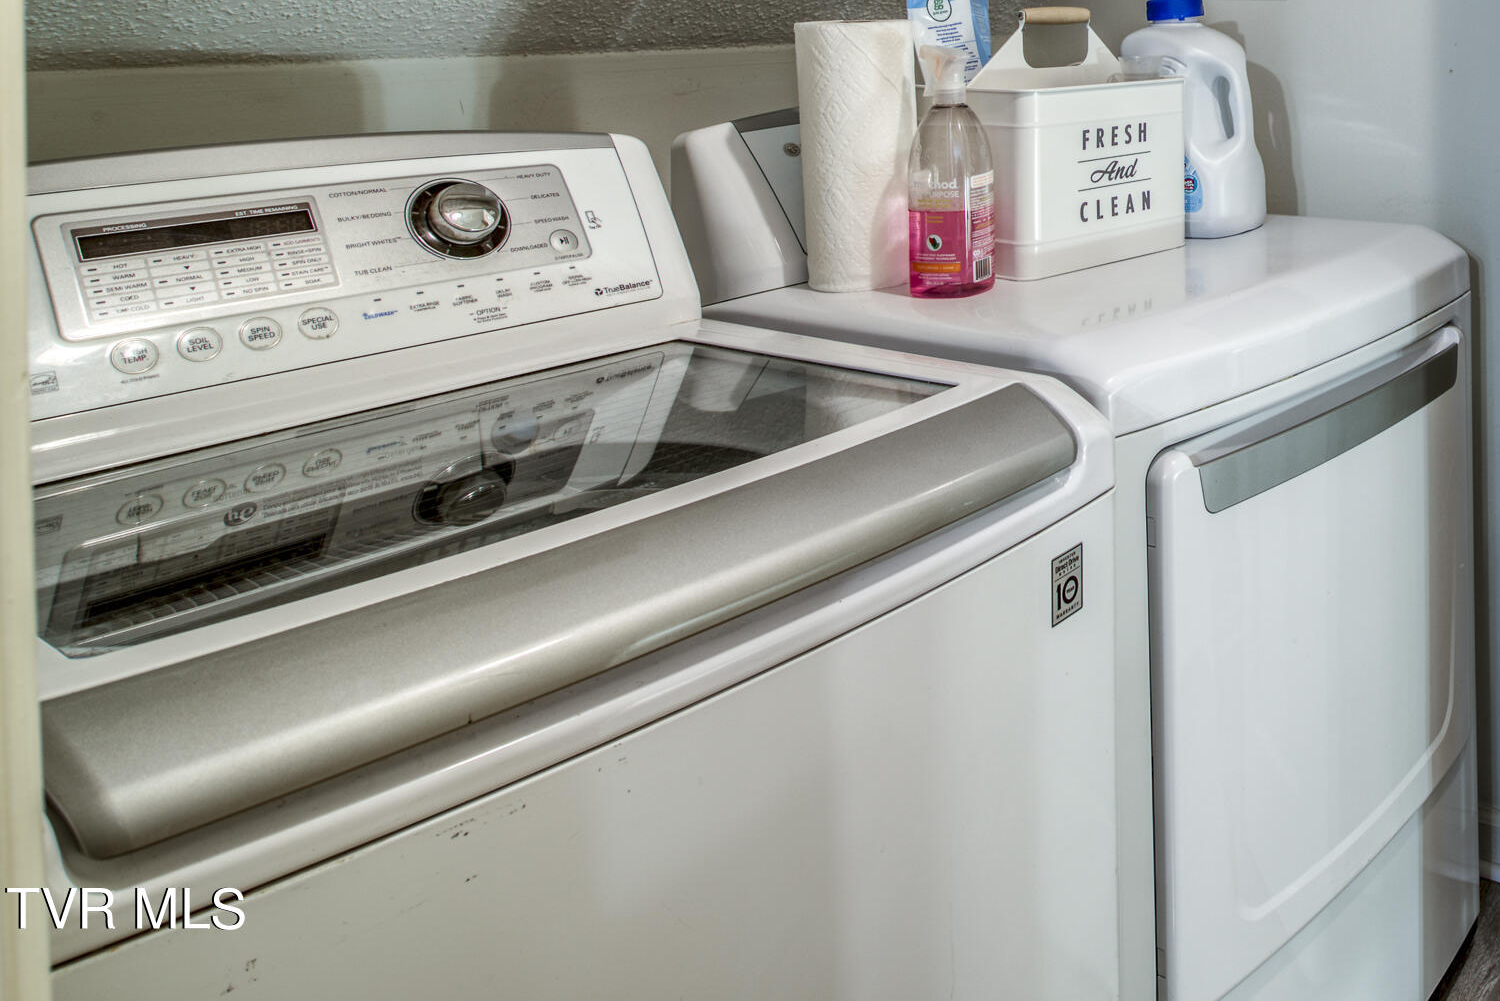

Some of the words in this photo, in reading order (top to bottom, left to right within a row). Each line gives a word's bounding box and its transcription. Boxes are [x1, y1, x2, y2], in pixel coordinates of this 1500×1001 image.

[1082, 122, 1147, 150] FRESH
[1090, 158, 1139, 183] And
[328, 187, 388, 198] COTTON/NORMAL
[530, 192, 560, 200] DELICATES
[926, 190, 960, 198] URPOSE
[1080, 190, 1151, 223] CLEAN
[337, 211, 392, 223] BULKY/BEDDING
[103, 222, 148, 233] PROCESSING
[510, 242, 548, 253] DOWNLOADED
[371, 265, 393, 274] CLEAN
[476, 307, 501, 316] OPTION
[302, 315, 334, 326] SPECIAL
[250, 326, 271, 336] SPIN
[311, 322, 328, 331] USE
[188, 337, 209, 347] SOIL
[248, 331, 276, 342] SPEED
[186, 342, 214, 354] LEVEL
[1056, 575, 1079, 611] 10
